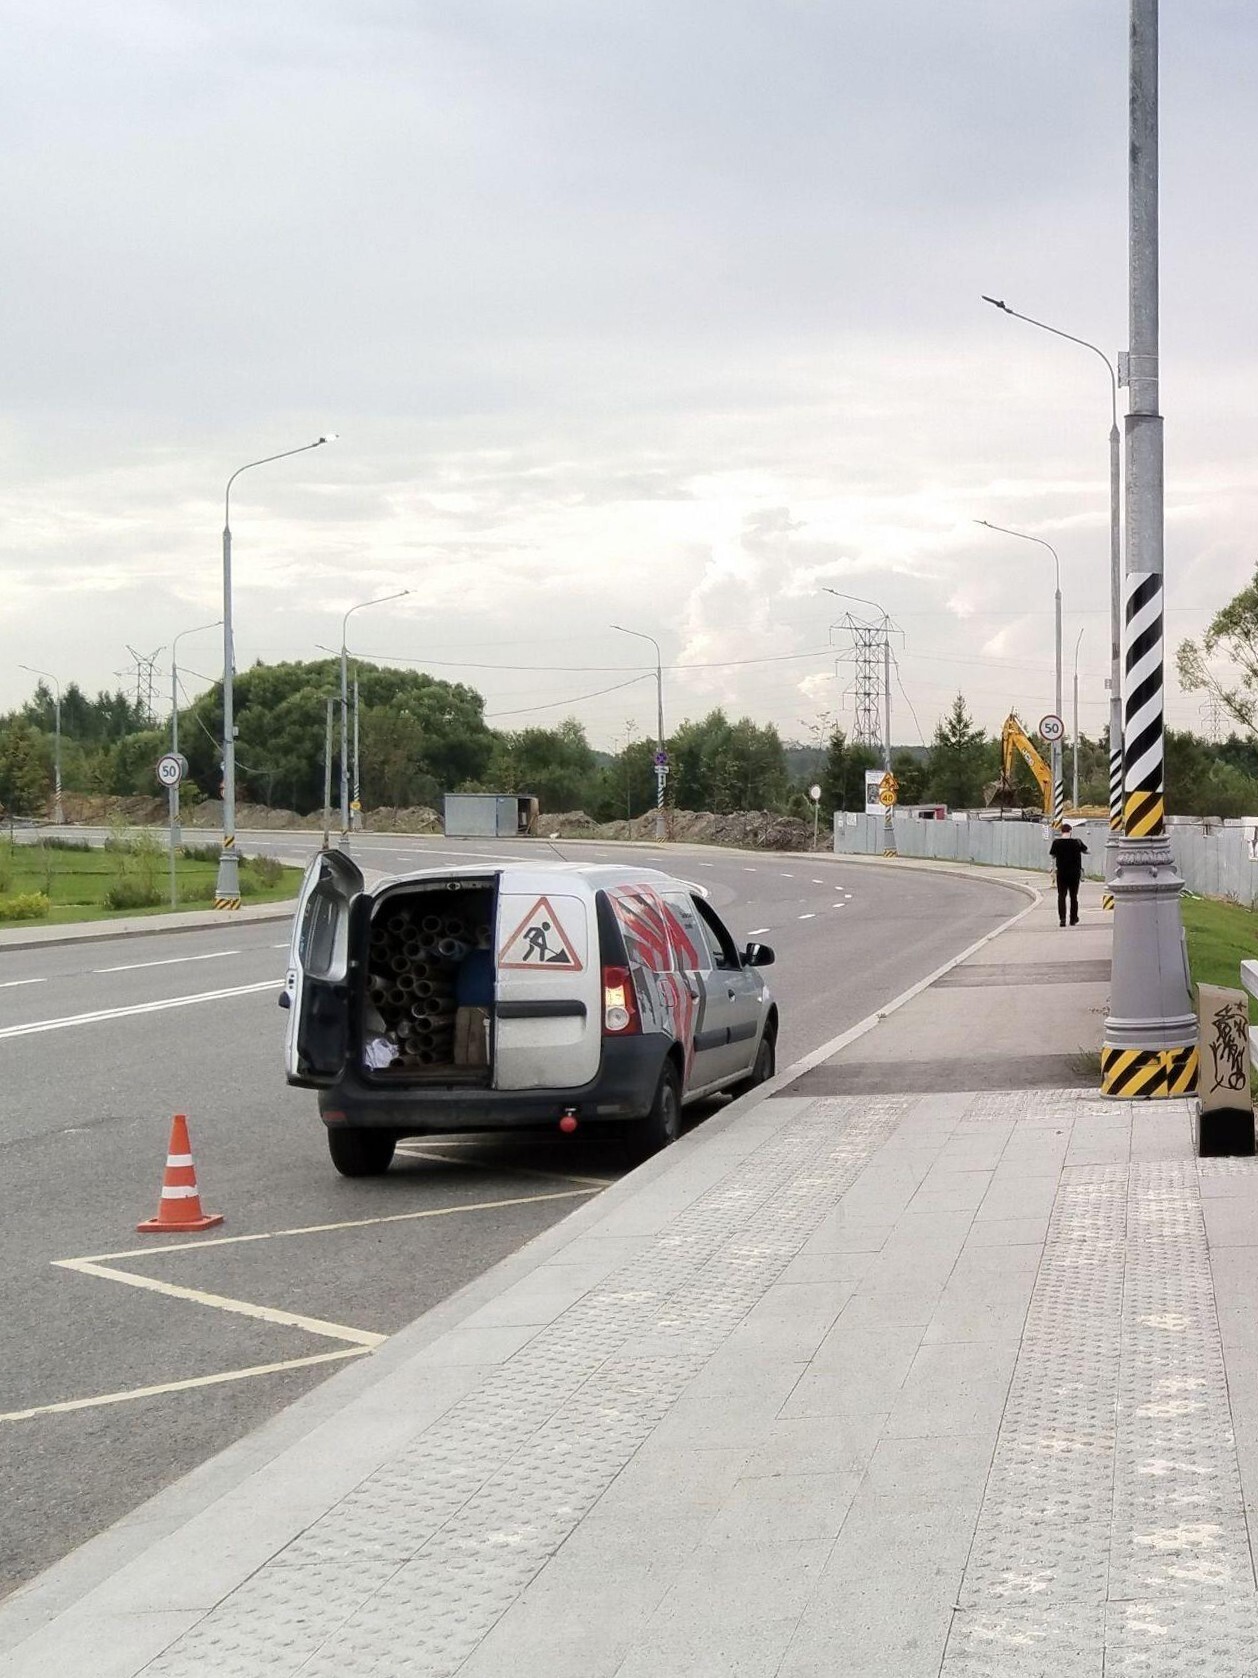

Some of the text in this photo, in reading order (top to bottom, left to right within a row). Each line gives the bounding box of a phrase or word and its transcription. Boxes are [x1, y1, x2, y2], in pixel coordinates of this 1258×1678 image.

[1044, 723, 1059, 734] 50
[162, 765, 176, 778] 50
[882, 794, 894, 802] 40
